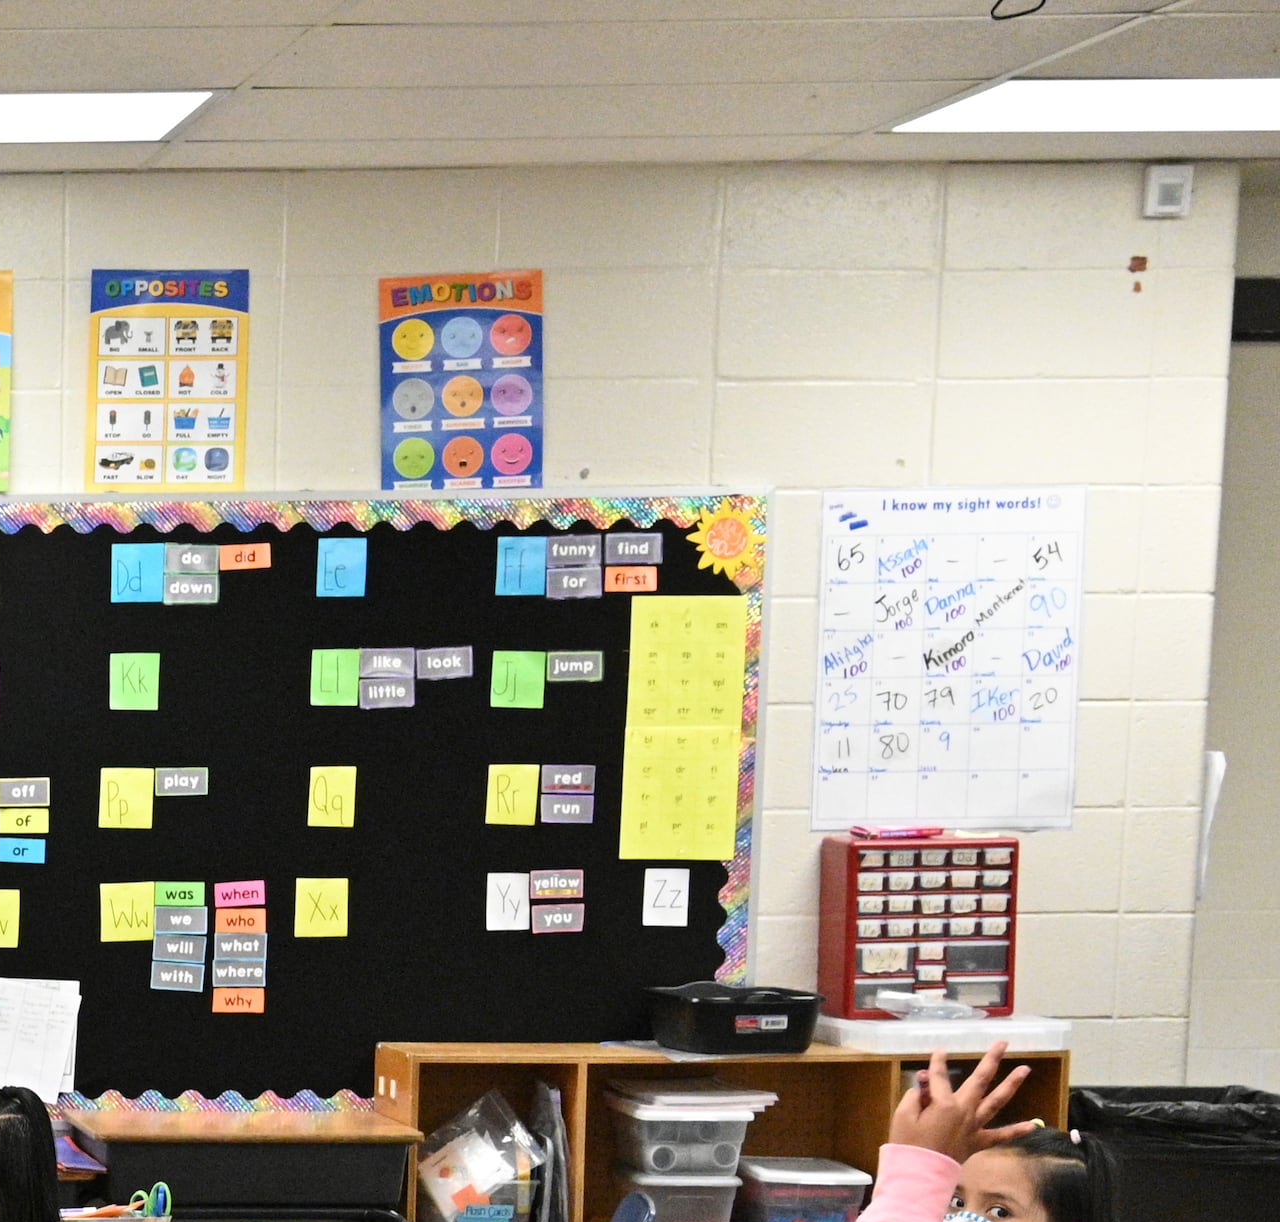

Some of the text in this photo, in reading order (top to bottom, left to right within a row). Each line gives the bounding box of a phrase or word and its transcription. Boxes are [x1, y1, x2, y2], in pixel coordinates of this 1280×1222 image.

[105, 279, 230, 298] OPPOSITES
[391, 279, 533, 308] EMOTIONS
[891, 499, 929, 512] know
[932, 500, 953, 515] my
[957, 498, 991, 514] sight
[995, 497, 1042, 511] words!
[234, 549, 256, 563] did
[551, 542, 596, 559] funny
[616, 541, 649, 557] find
[838, 542, 866, 572] 65
[1032, 540, 1064, 571] 54
[169, 580, 214, 595] down
[561, 574, 587, 589] for
[614, 571, 648, 588] first
[874, 588, 920, 624] Jorge
[924, 582, 977, 617] Danna
[1021, 627, 1075, 672] David
[372, 655, 402, 670] like
[426, 653, 462, 669] look
[552, 658, 594, 675] jump
[367, 683, 407, 700] little
[1028, 686, 1059, 712] 20
[875, 689, 909, 713] 70
[879, 731, 911, 760] 80
[163, 773, 200, 791] play
[553, 771, 583, 786] red
[11, 784, 36, 798] off
[552, 801, 581, 815] run
[533, 875, 581, 893] yellow
[165, 888, 195, 901] was
[220, 887, 260, 901] when
[651, 878, 684, 910] Zz
[169, 914, 192, 926] we
[225, 914, 256, 928] who
[543, 910, 574, 927] you
[166, 940, 194, 954] will
[220, 938, 260, 953] what
[159, 969, 194, 985] with
[215, 964, 263, 980] where
[223, 993, 253, 1010] why
